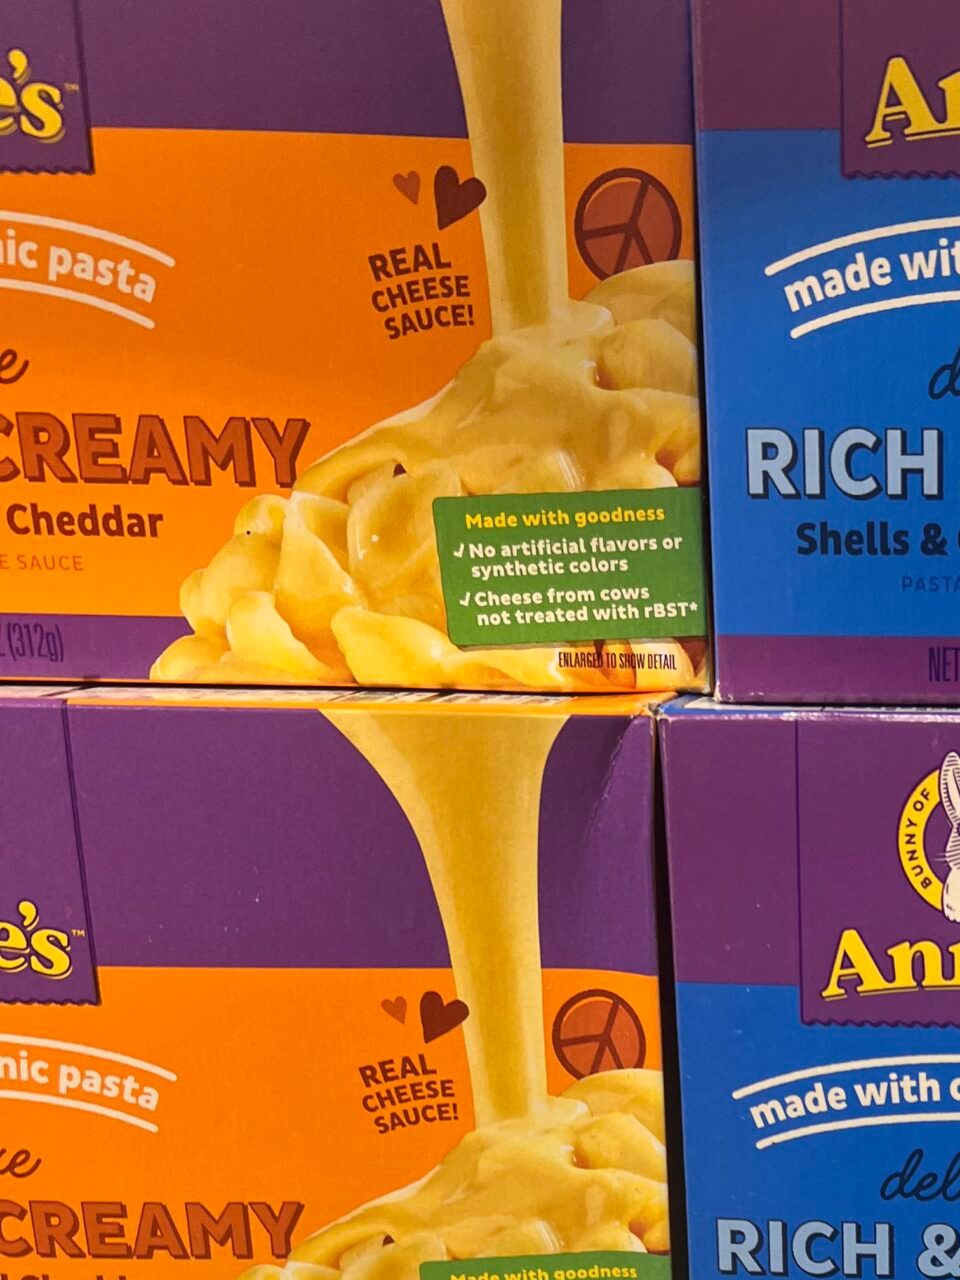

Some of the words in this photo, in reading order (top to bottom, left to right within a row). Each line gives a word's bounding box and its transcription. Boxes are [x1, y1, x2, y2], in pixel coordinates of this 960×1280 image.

[48, 253, 158, 304] pasta
[368, 242, 452, 282] REAL
[783, 253, 892, 313] made
[370, 274, 471, 315] CHEESE
[384, 304, 476, 340] SAUCE!
[746, 426, 944, 500] RICH
[6, 503, 163, 539] Cheddar
[913, 786, 931, 814] OF
[904, 817, 933, 890] BUNNY
[58, 1064, 161, 1113] pasta
[750, 1081, 847, 1129] made
[853, 1073, 941, 1106] with
[716, 1217, 896, 1279] RICH
